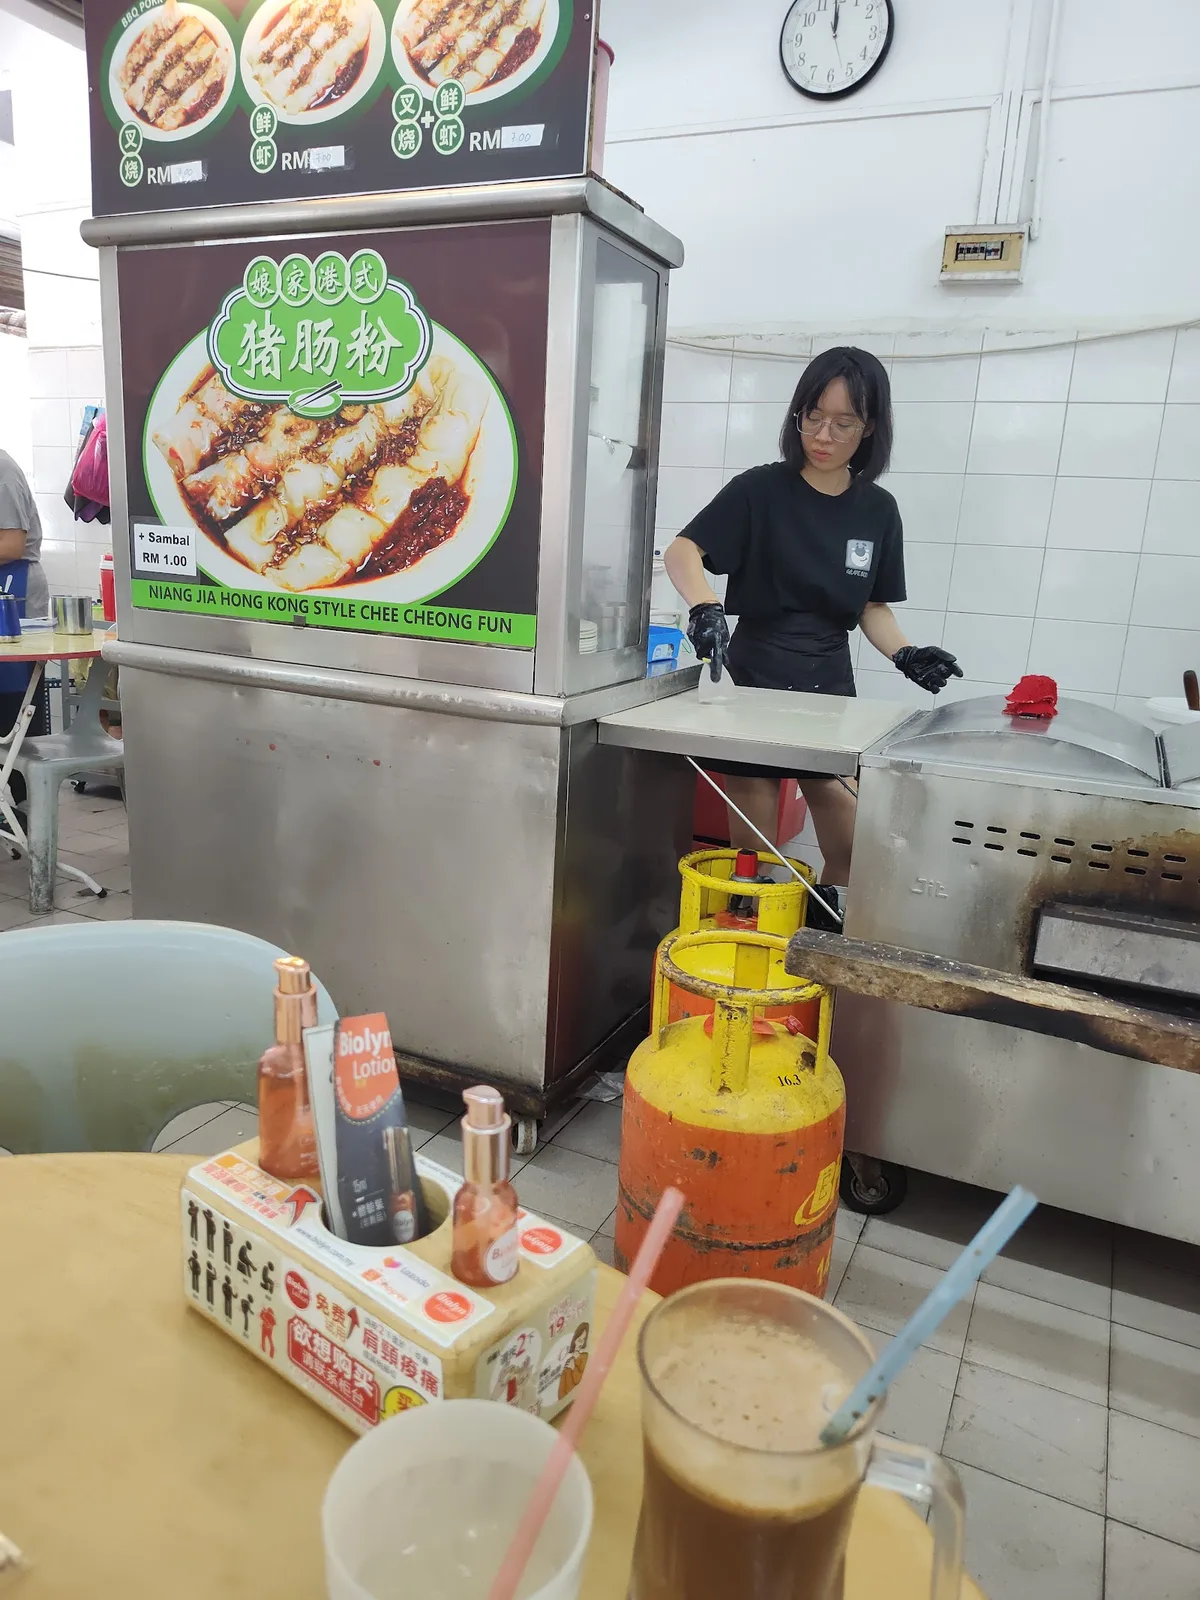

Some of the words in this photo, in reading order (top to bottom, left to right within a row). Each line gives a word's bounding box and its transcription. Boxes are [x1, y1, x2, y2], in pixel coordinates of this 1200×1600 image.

[121, 7, 139, 28] BBQ
[802, 12, 816, 28] 10
[865, 4, 874, 19] 2
[794, 33, 803, 48] 9
[868, 25, 878, 41] 3
[797, 52, 806, 67] 8
[860, 46, 868, 60] 4
[810, 65, 818, 80] 7
[826, 68, 835, 83] 6
[845, 62, 854, 77] 5
[397, 93, 416, 151] 叉烧
[438, 87, 459, 147] 鲜虾
[255, 111, 272, 167] 鲜虾
[469, 130, 501, 152] RM
[124, 129, 139, 180] 叉烧
[281, 151, 308, 171] RM
[147, 166, 171, 184] RM
[249, 260, 379, 298] 娘家港式
[237, 309, 403, 381] 猪肠粉
[148, 532, 190, 547] Sambal
[142, 552, 159, 565] RM
[163, 554, 187, 567] 1.00
[149, 584, 192, 602] NIANG
[196, 589, 216, 606] JIA
[221, 591, 263, 610] HONG
[268, 596, 309, 614] KONG
[313, 601, 356, 618] STYLE
[360, 604, 399, 622] CHEE
[403, 608, 472, 630] CHEONG
[478, 615, 512, 633] FUN
[777, 1074, 802, 1088] 16.3
[400, 1266, 431, 1288] Lazada
